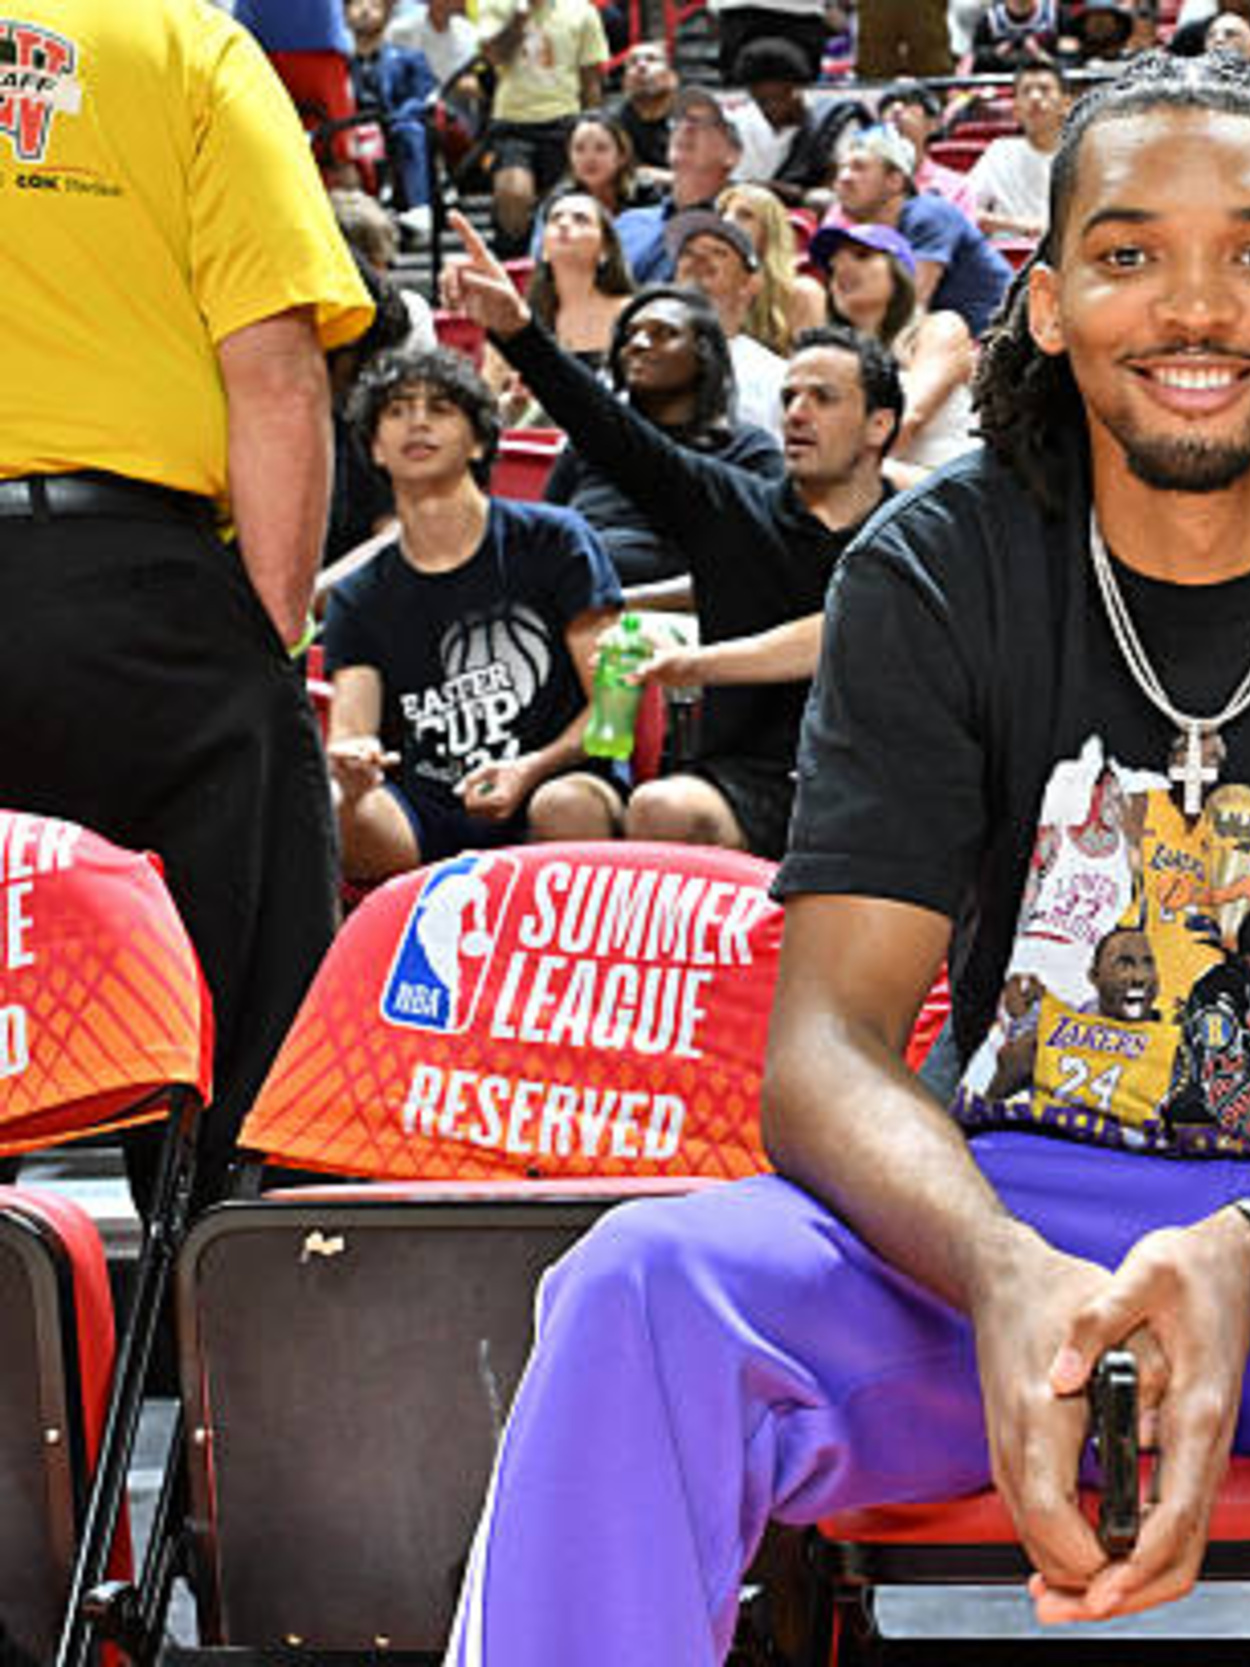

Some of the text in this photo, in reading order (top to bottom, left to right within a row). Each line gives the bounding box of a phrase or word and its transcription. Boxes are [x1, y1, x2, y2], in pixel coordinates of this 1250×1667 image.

[0, 810, 82, 882] ER
[519, 861, 768, 965] SUMMER
[392, 982, 440, 1019] NBA
[490, 951, 715, 1059] LEAGUE
[1045, 1016, 1149, 1060] LAKERS
[403, 1063, 687, 1160] RESERVED
[1057, 1055, 1125, 1111] 24
